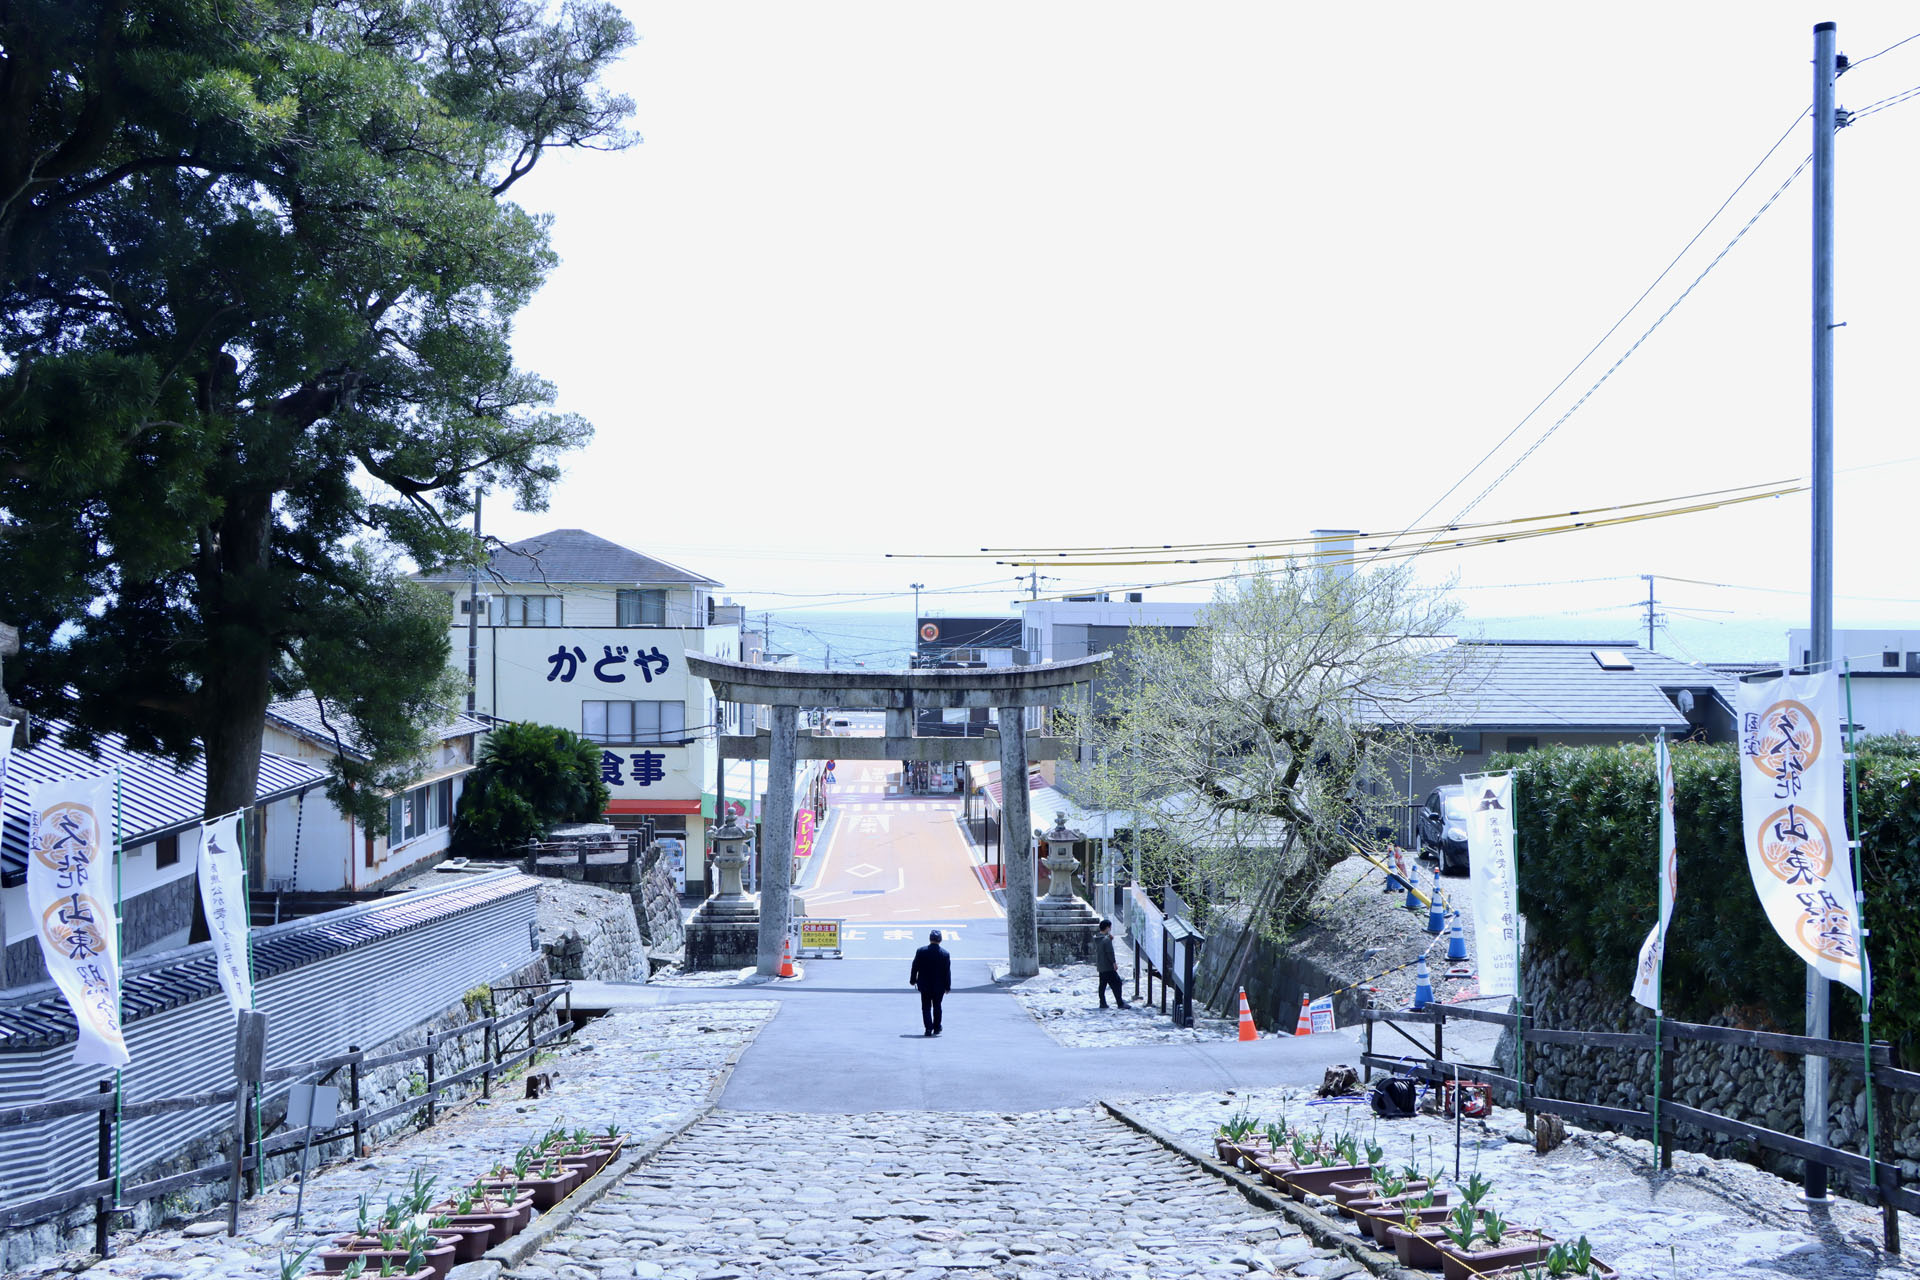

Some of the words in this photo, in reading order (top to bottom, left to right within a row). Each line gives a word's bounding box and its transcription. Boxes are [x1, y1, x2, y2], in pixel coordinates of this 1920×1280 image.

[547, 645, 669, 683] かどや
[798, 812, 813, 854] クレープ
